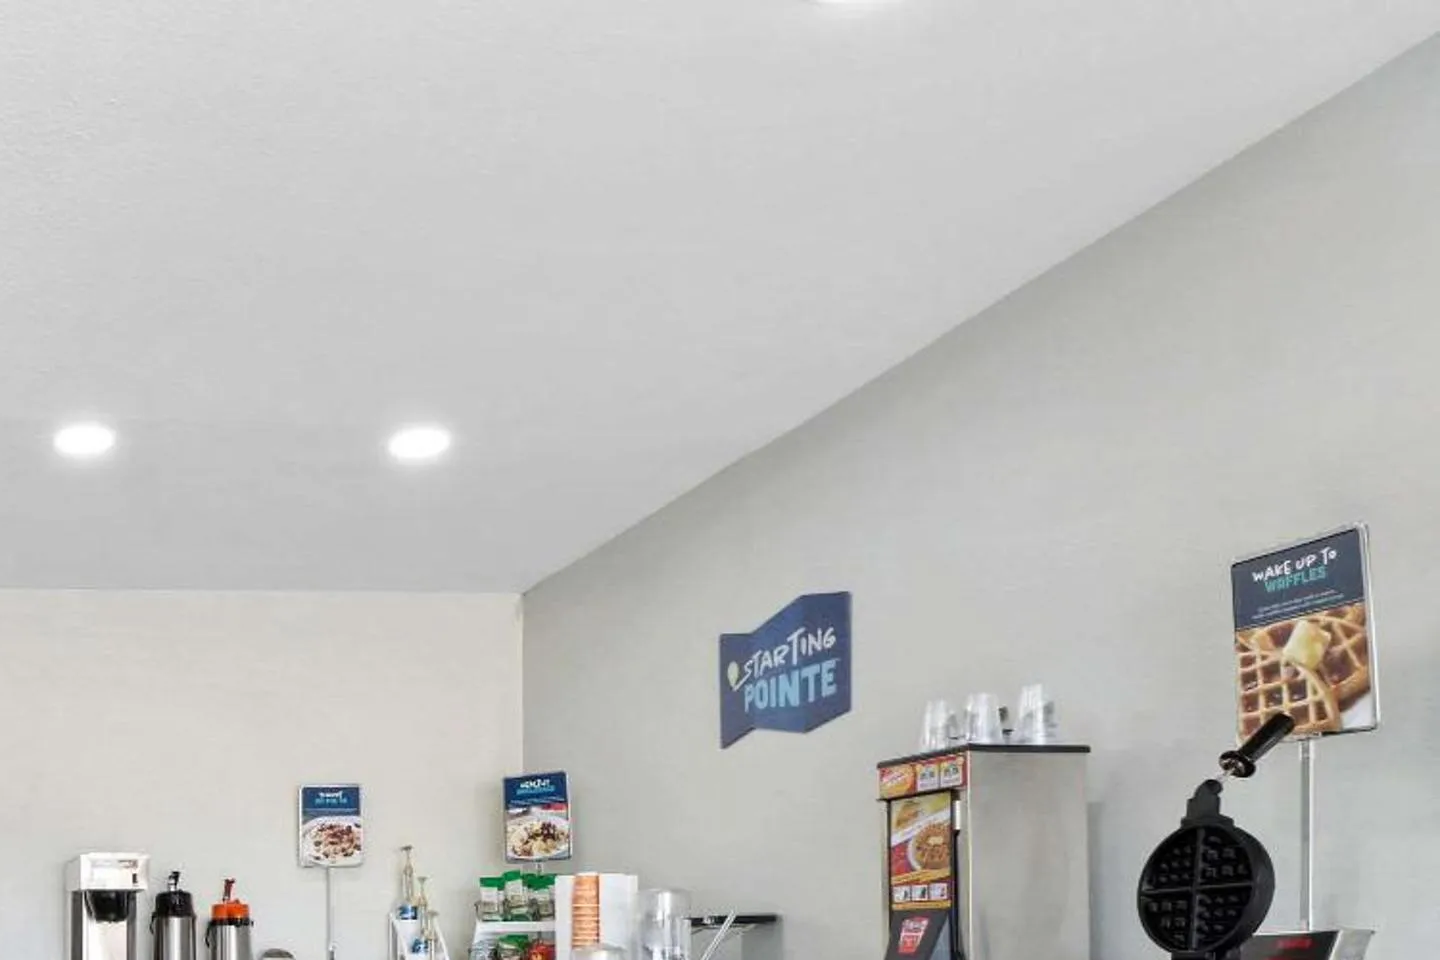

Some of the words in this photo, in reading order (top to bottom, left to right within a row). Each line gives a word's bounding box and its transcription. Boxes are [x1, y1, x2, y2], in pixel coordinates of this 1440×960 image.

[1252, 559, 1291, 583] WAKE
[1295, 553, 1317, 571] UP
[1263, 565, 1327, 593] WAFFLES
[743, 627, 836, 682] STARTING
[744, 659, 837, 713] POINTE
